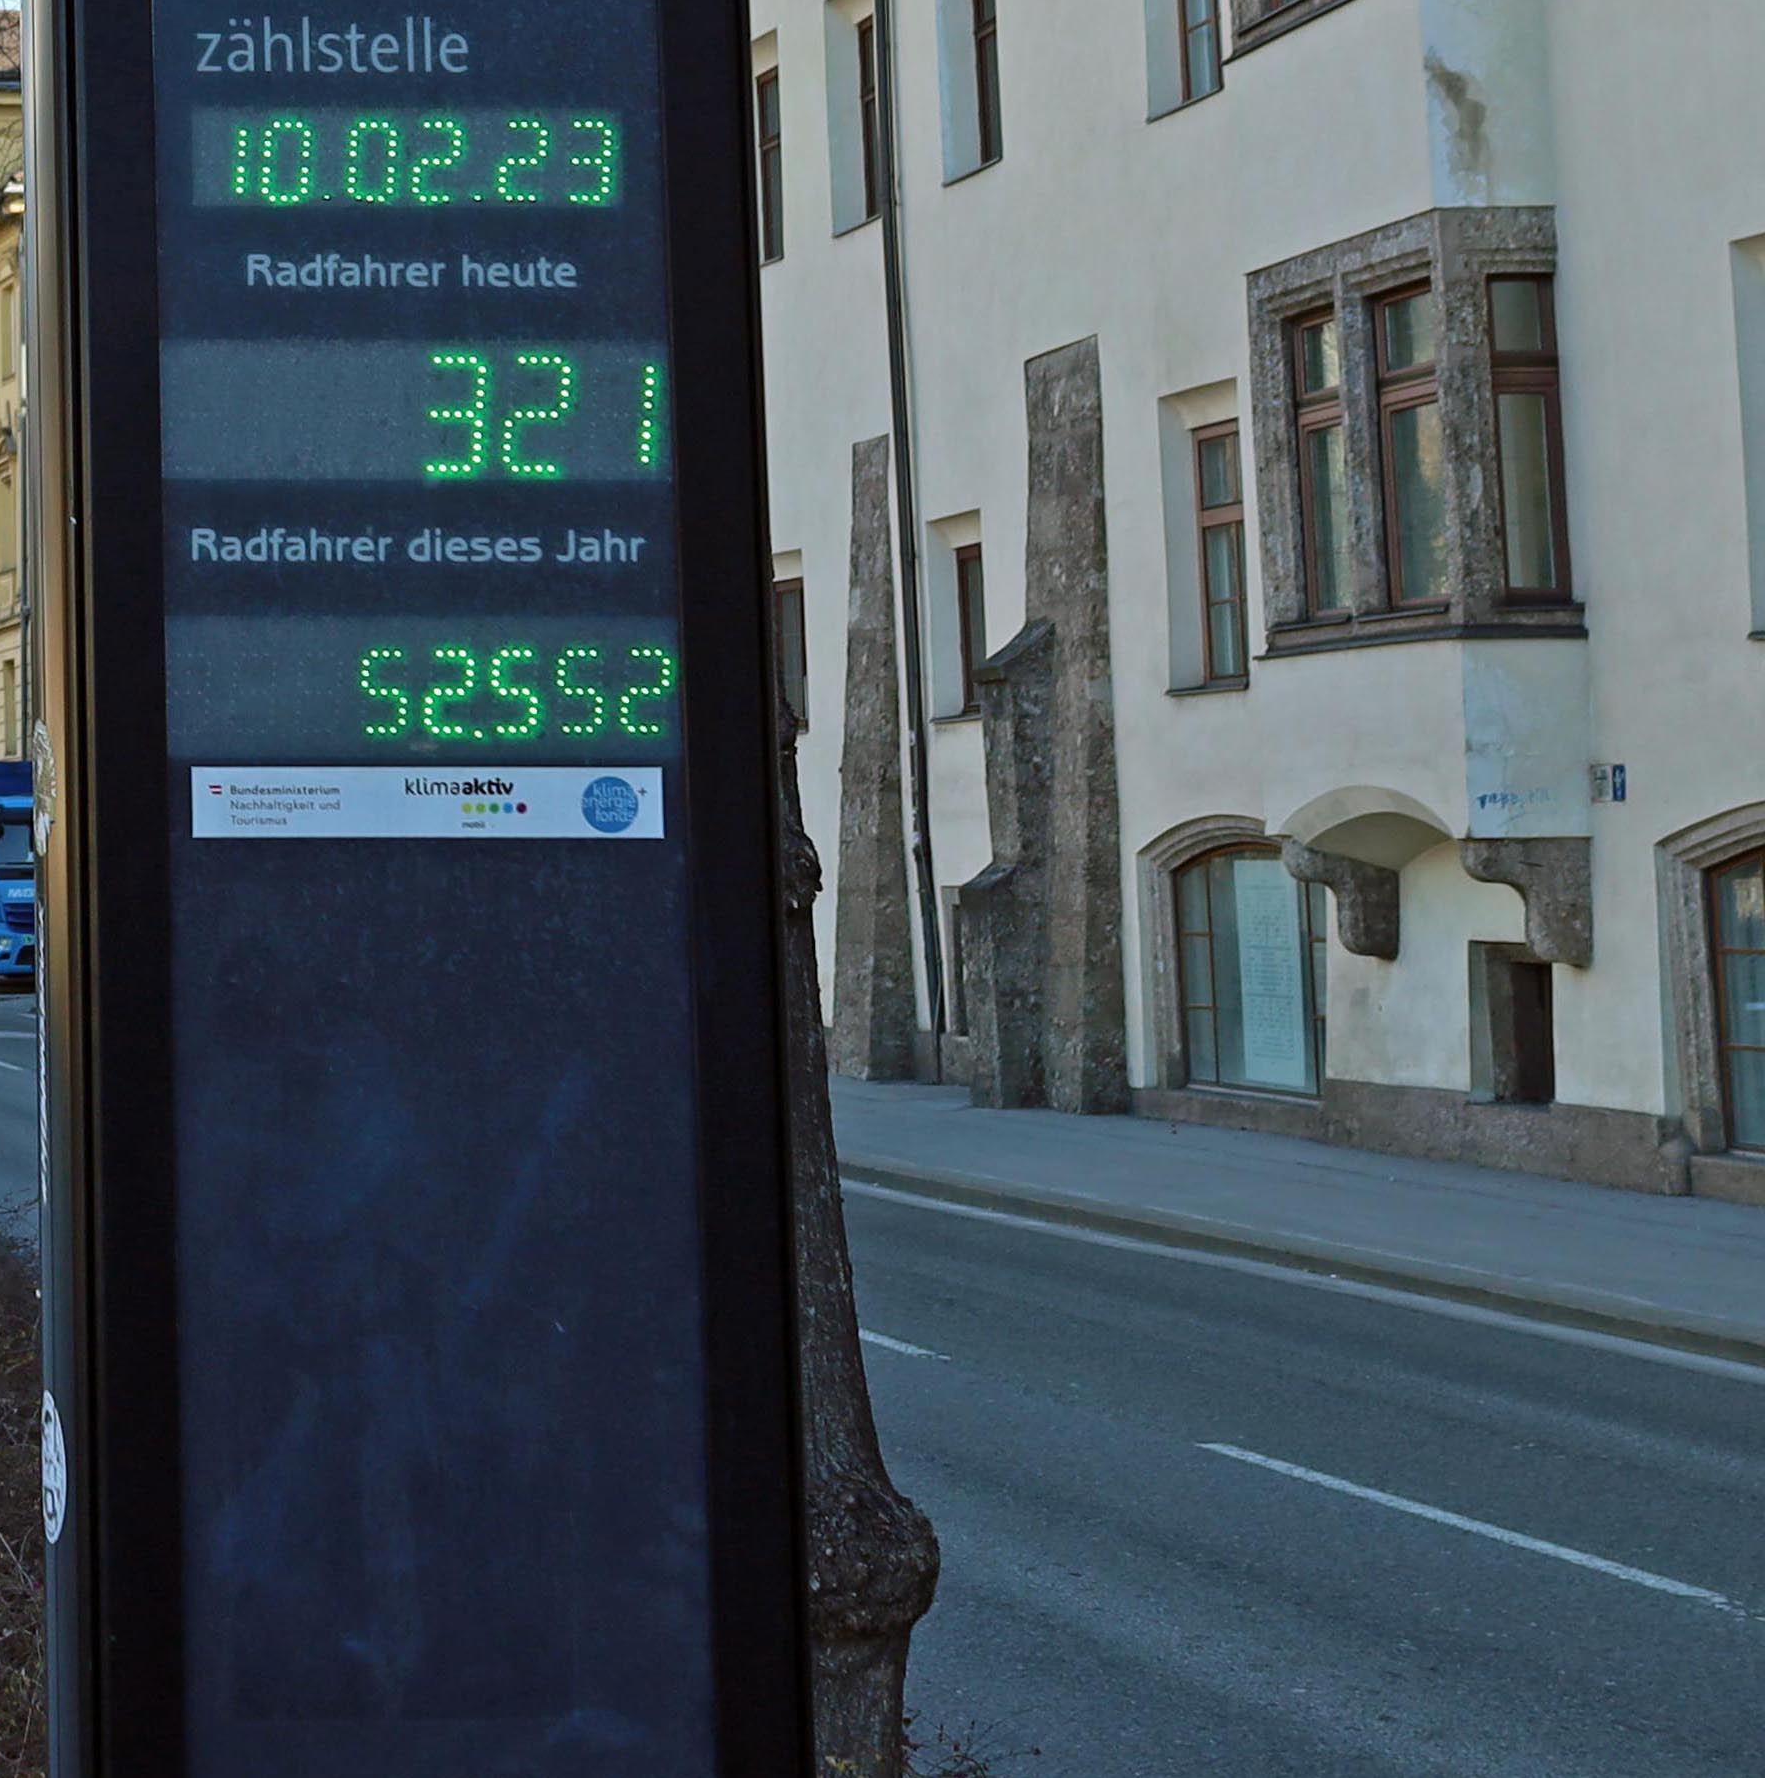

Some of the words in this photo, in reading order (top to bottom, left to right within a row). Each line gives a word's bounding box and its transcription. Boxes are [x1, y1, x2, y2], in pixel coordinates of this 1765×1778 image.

[195, 17, 470, 73] zählstelle
[234, 120, 614, 203] 10.02.23
[247, 253, 446, 288] Radfahrer
[462, 253, 578, 288] heute
[425, 354, 657, 474] 321
[191, 527, 394, 563] Radfahrer
[407, 527, 543, 563] dieses
[555, 527, 647, 564] Jahr
[229, 784, 341, 796] Bundesministerium
[404, 777, 515, 797] klimaaktiv
[229, 799, 315, 814] Nachhaltigkeit
[318, 799, 342, 811] und
[230, 814, 289, 826] Tourismus
